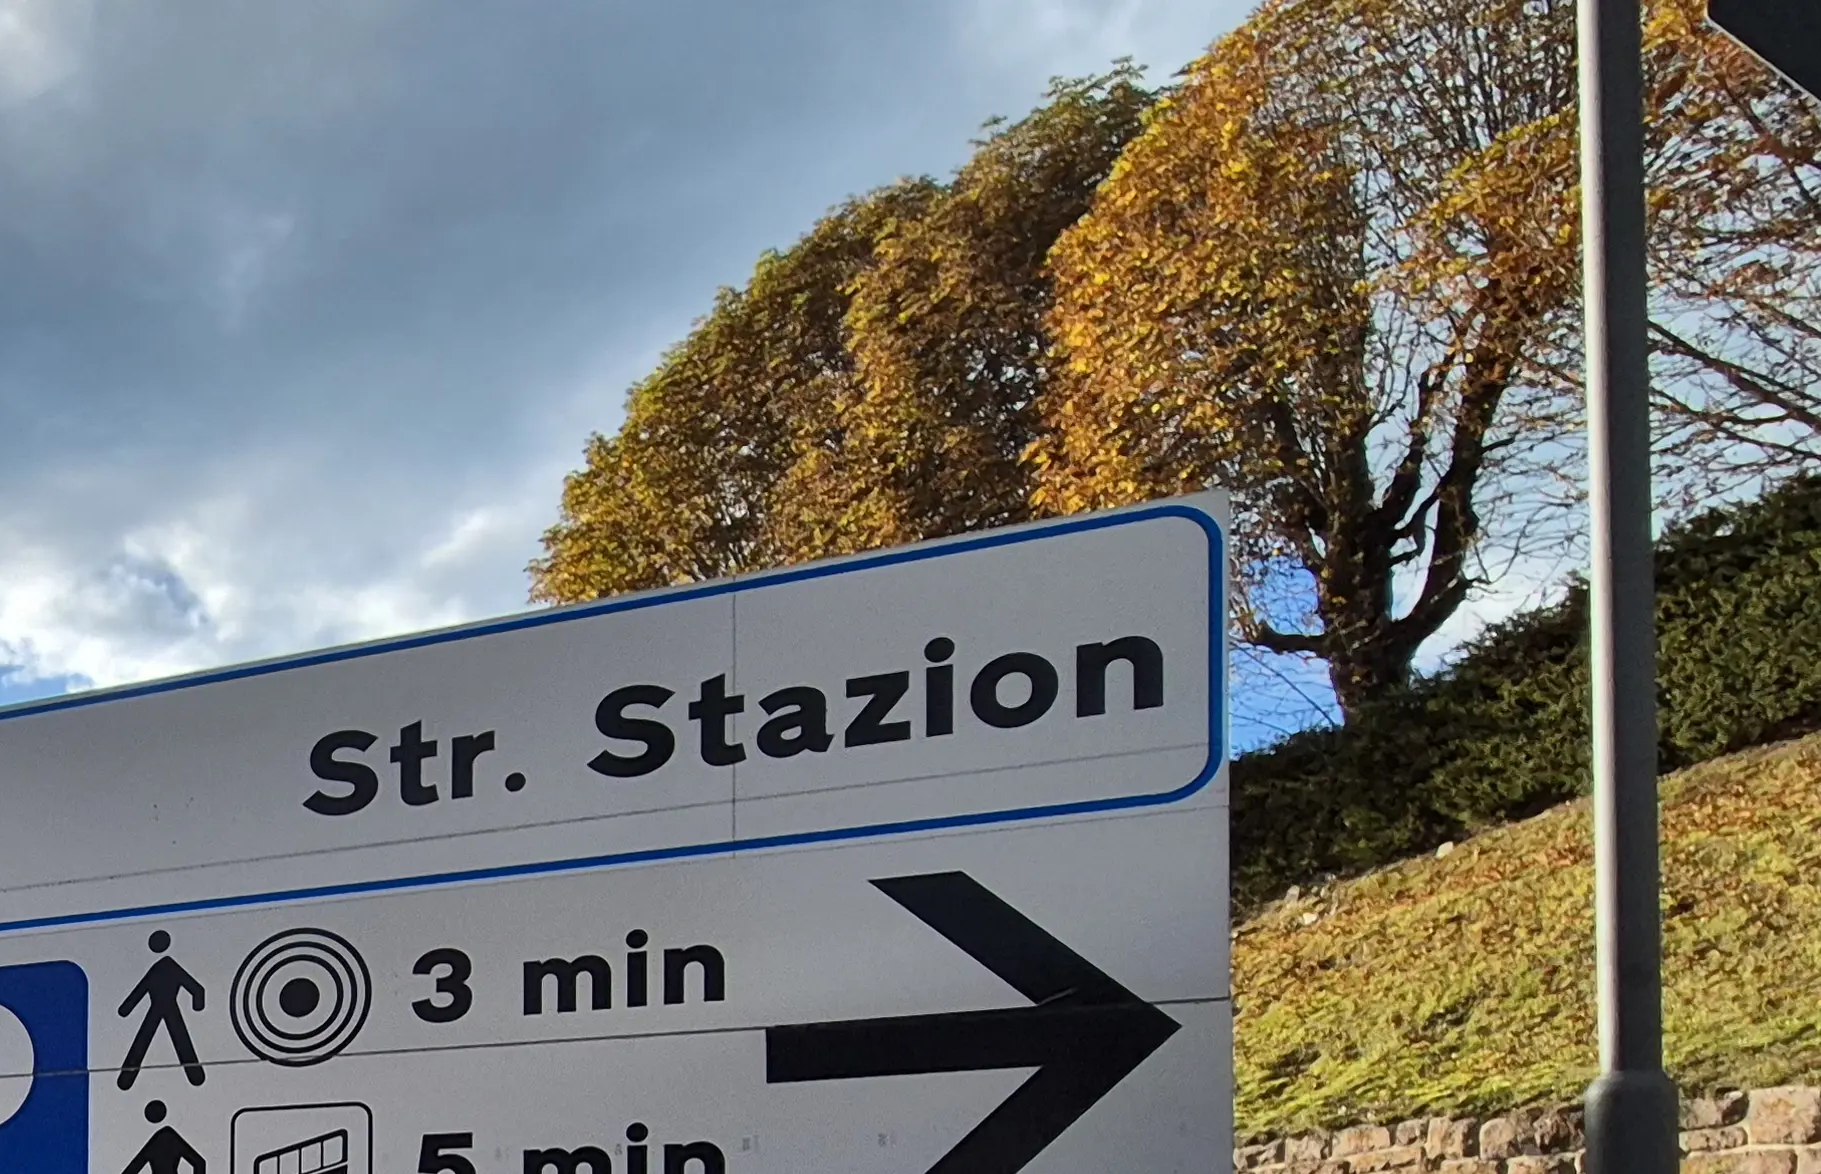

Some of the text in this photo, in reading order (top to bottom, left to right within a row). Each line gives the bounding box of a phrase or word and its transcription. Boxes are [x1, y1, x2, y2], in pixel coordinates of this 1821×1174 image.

[303, 636, 1163, 816] Str. Stazion
[412, 929, 724, 1023] 3 min
